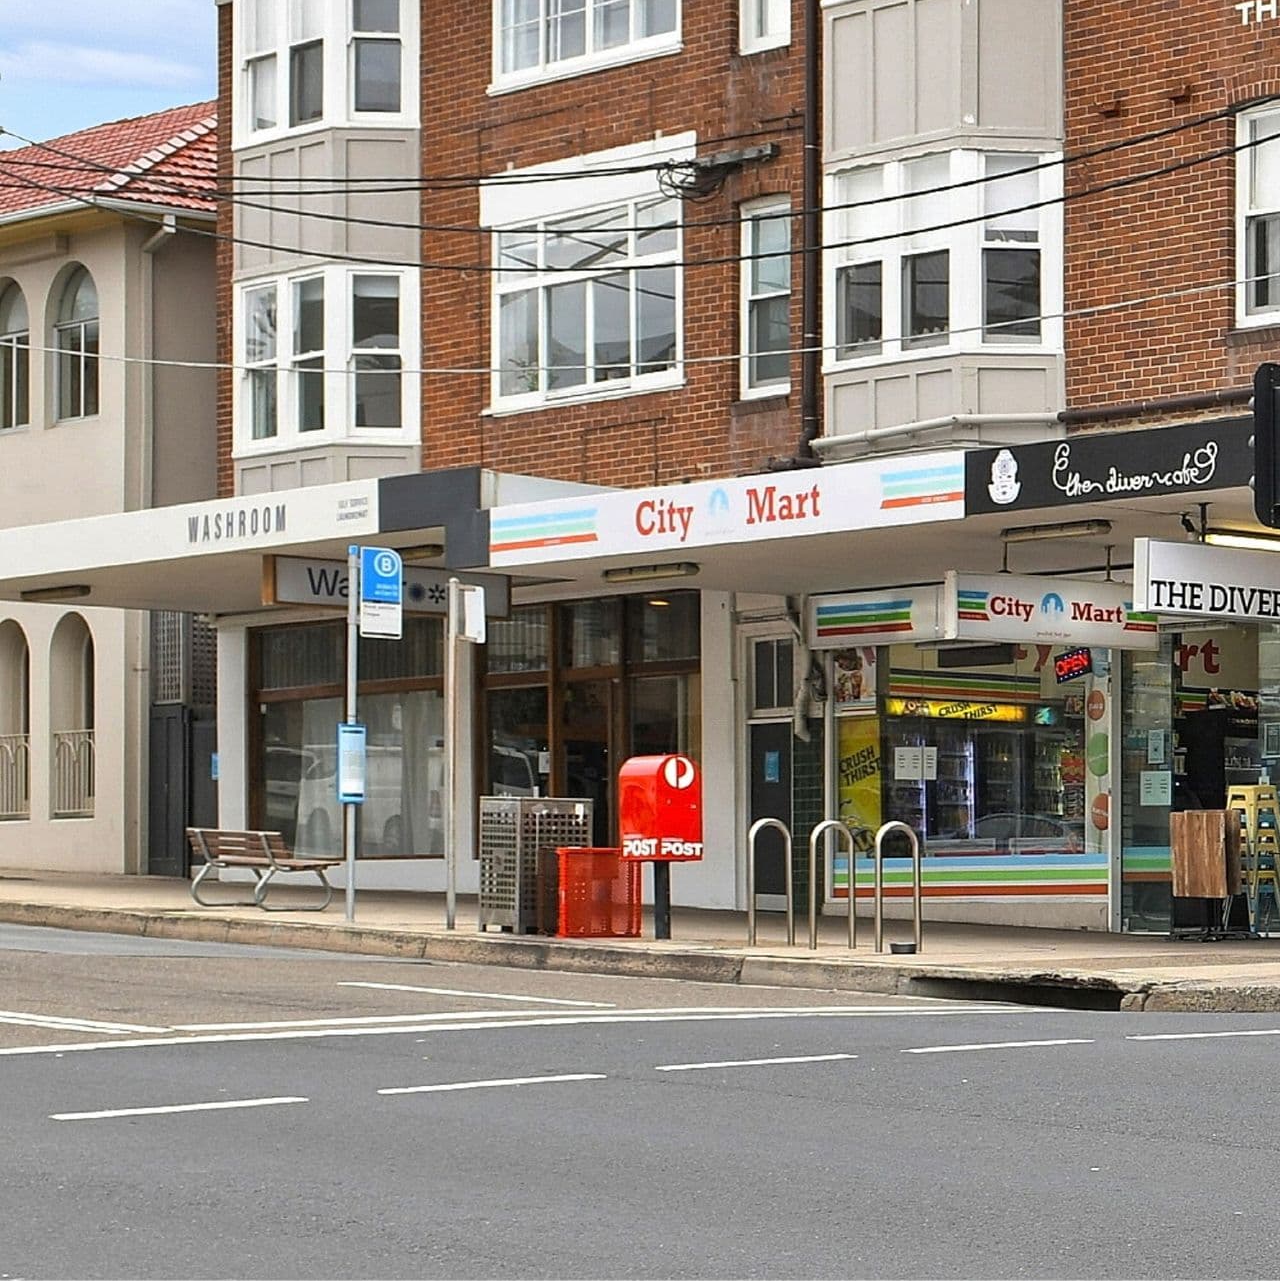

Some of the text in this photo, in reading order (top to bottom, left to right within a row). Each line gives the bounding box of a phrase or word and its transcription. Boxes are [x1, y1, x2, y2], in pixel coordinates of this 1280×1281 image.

[1106, 467, 1153, 493] diver
[188, 504, 286, 543] WASHROOM
[635, 484, 820, 542] City Mart
[1150, 580, 1204, 610] THE
[990, 596, 1124, 624] City Mart
[1055, 653, 1089, 675] OPEN
[938, 701, 971, 717] CRUSH
[963, 704, 998, 719] THIRST
[840, 745, 875, 773] CRUSH
[844, 756, 880, 786] THIRST
[623, 839, 658, 856] POST
[661, 843, 703, 856] POST
